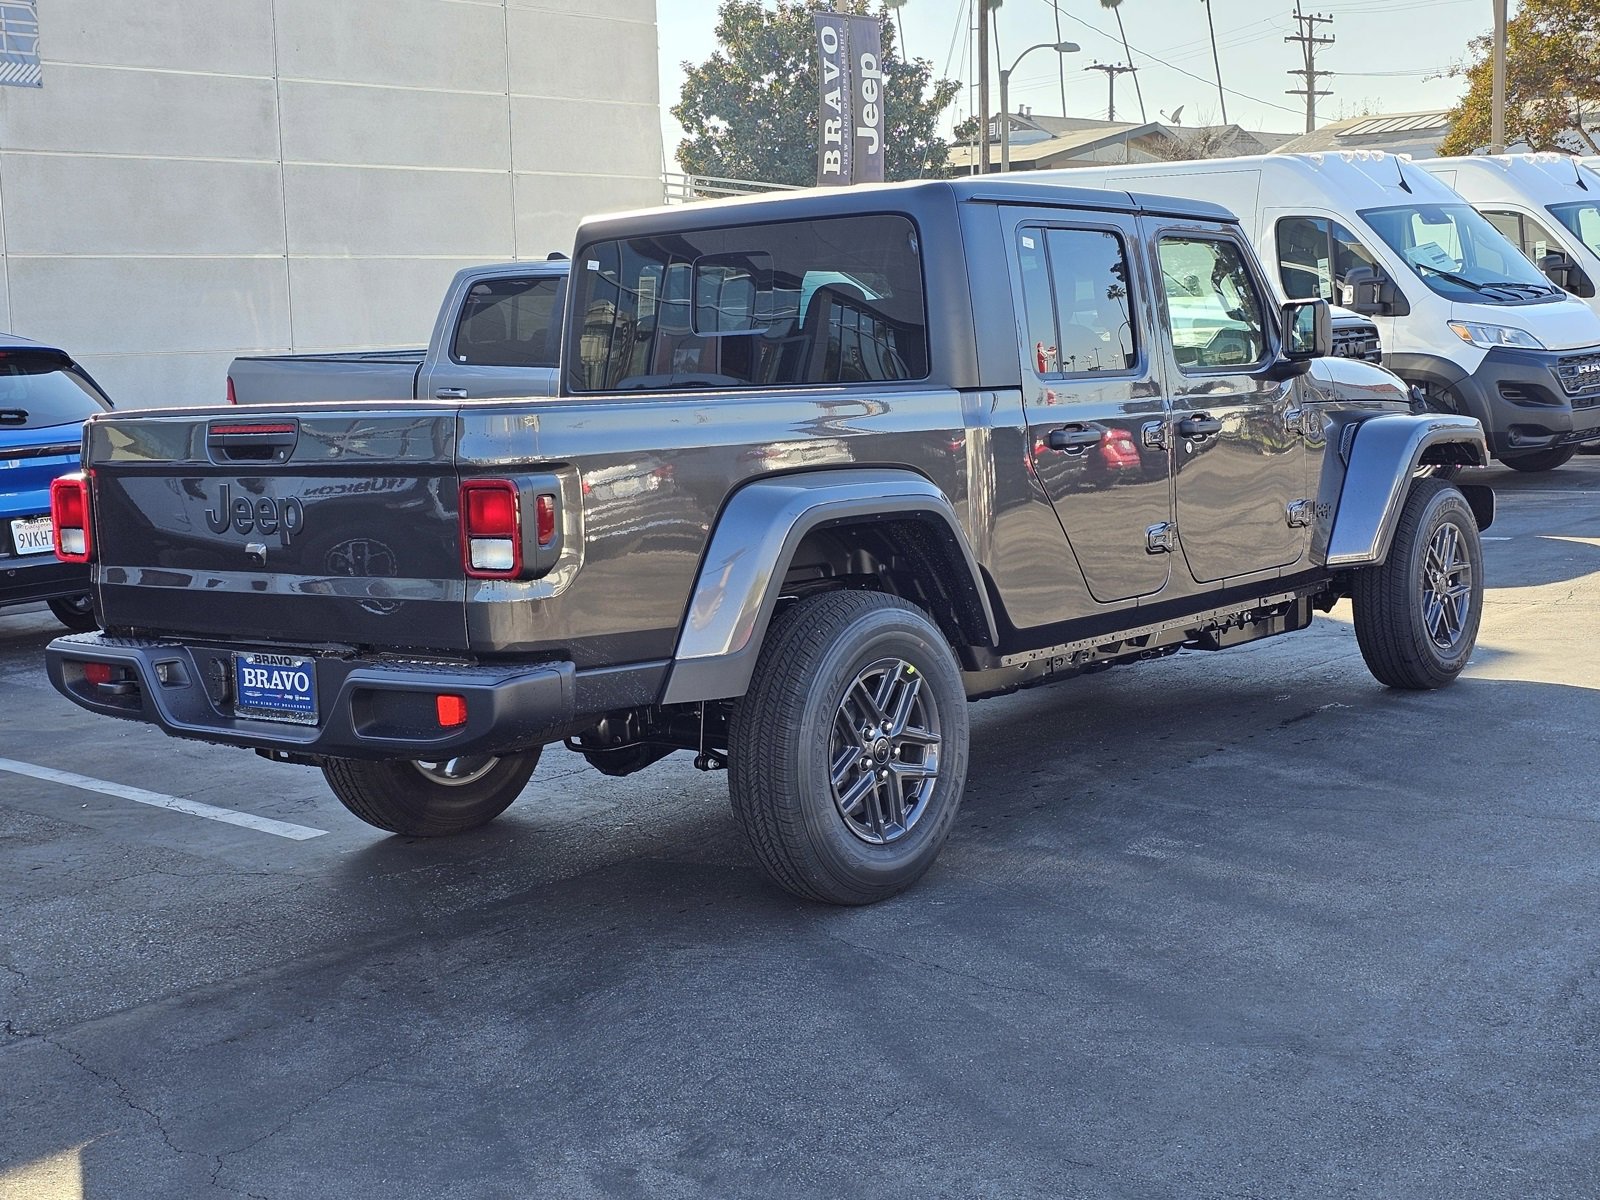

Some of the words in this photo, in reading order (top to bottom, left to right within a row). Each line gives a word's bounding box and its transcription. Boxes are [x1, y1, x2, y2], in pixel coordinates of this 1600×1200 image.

[820, 26, 842, 175] BRAVO
[857, 52, 881, 155] Jeep
[1331, 341, 1364, 354] AM
[1578, 362, 1600, 373] RA
[204, 483, 305, 545] Jeep
[253, 654, 292, 666] BRAVO
[242, 668, 309, 692] BRAVO
